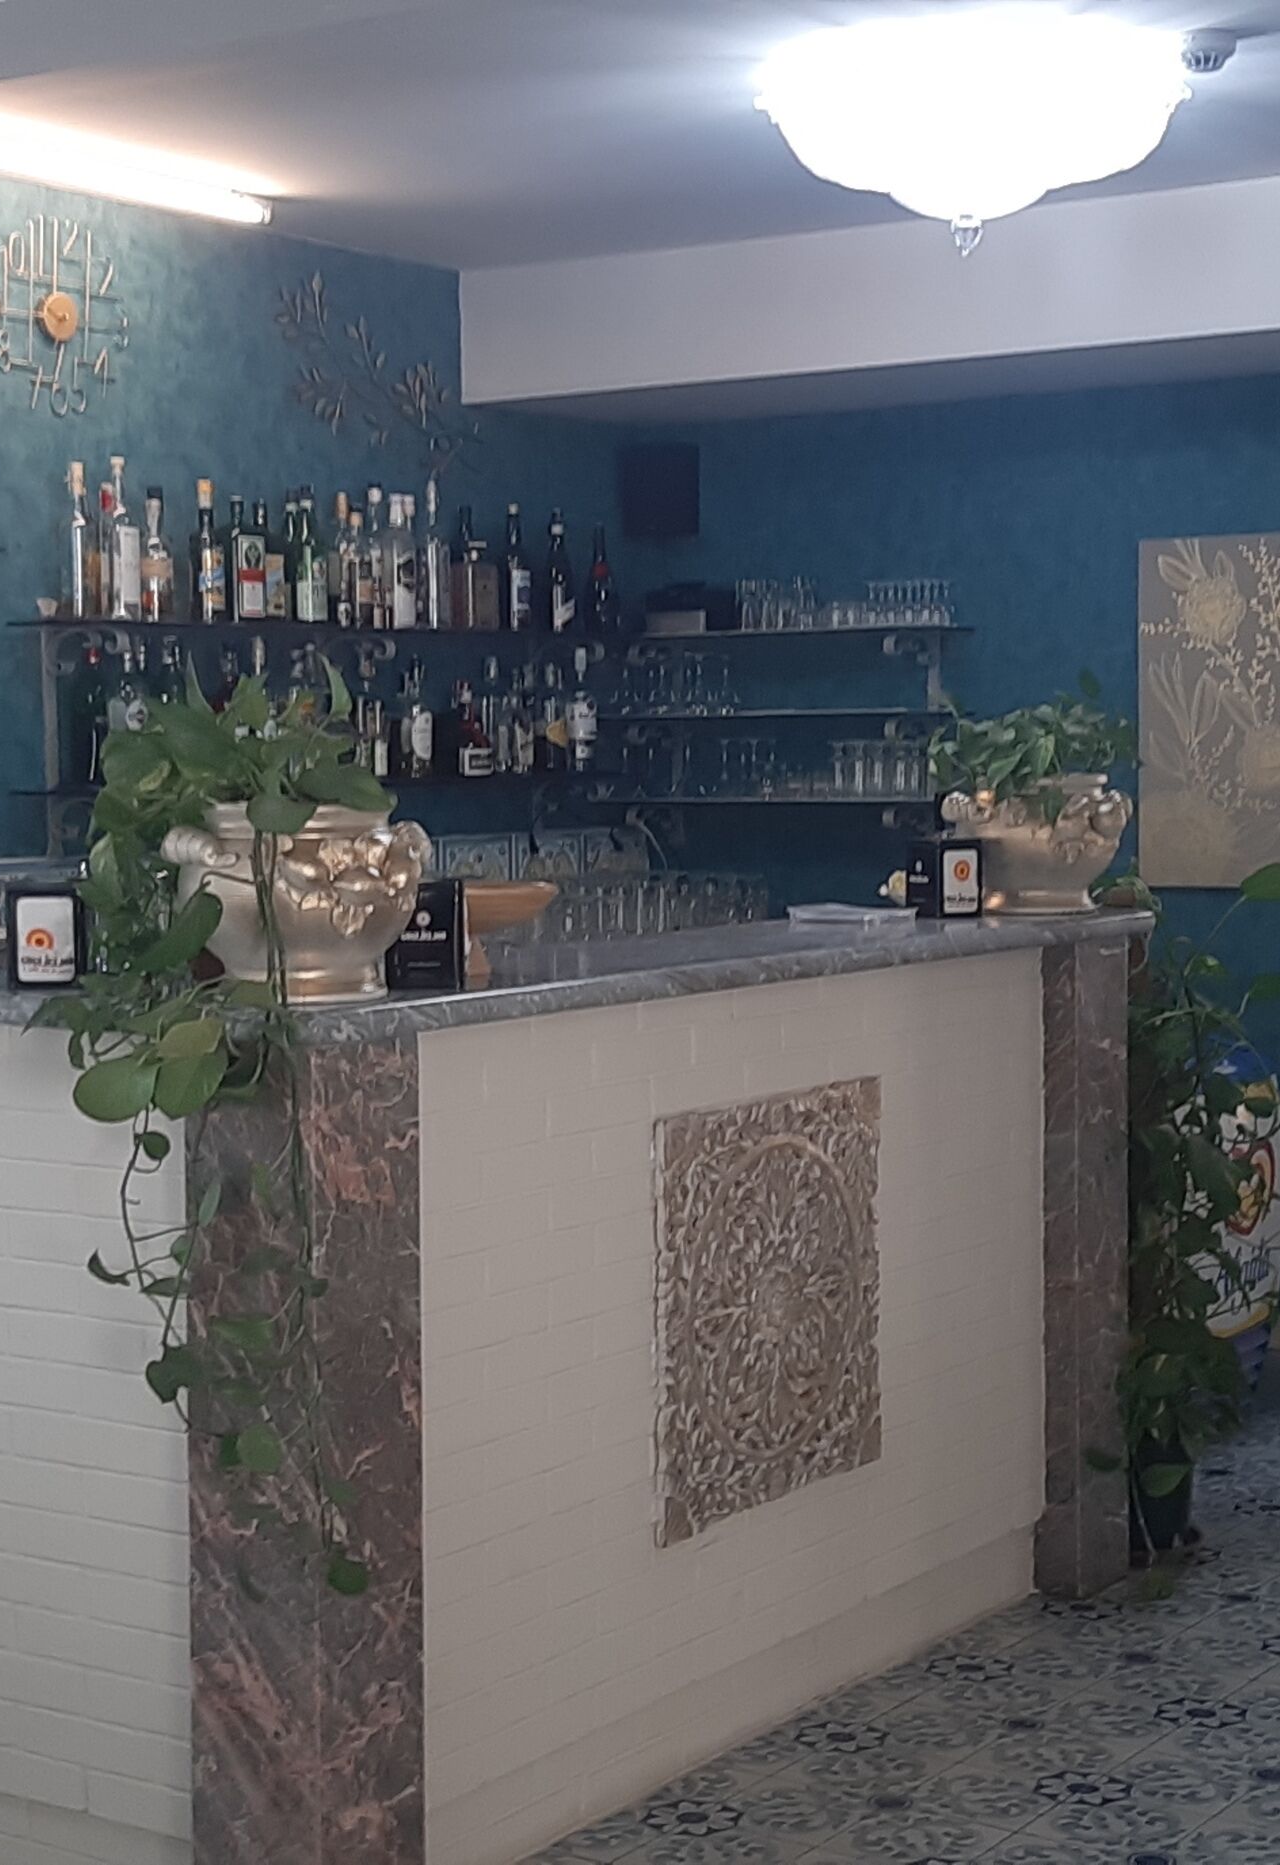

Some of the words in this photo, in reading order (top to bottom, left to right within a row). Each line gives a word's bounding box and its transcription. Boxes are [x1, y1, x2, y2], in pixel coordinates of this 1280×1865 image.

[0, 230, 25, 330] 10
[25, 213, 44, 362] 11
[48, 215, 83, 295] 12
[98, 255, 123, 301] 2
[29, 363, 45, 411] 7
[50, 338, 69, 417] 6
[70, 354, 87, 414] 5
[93, 346, 117, 399] 4
